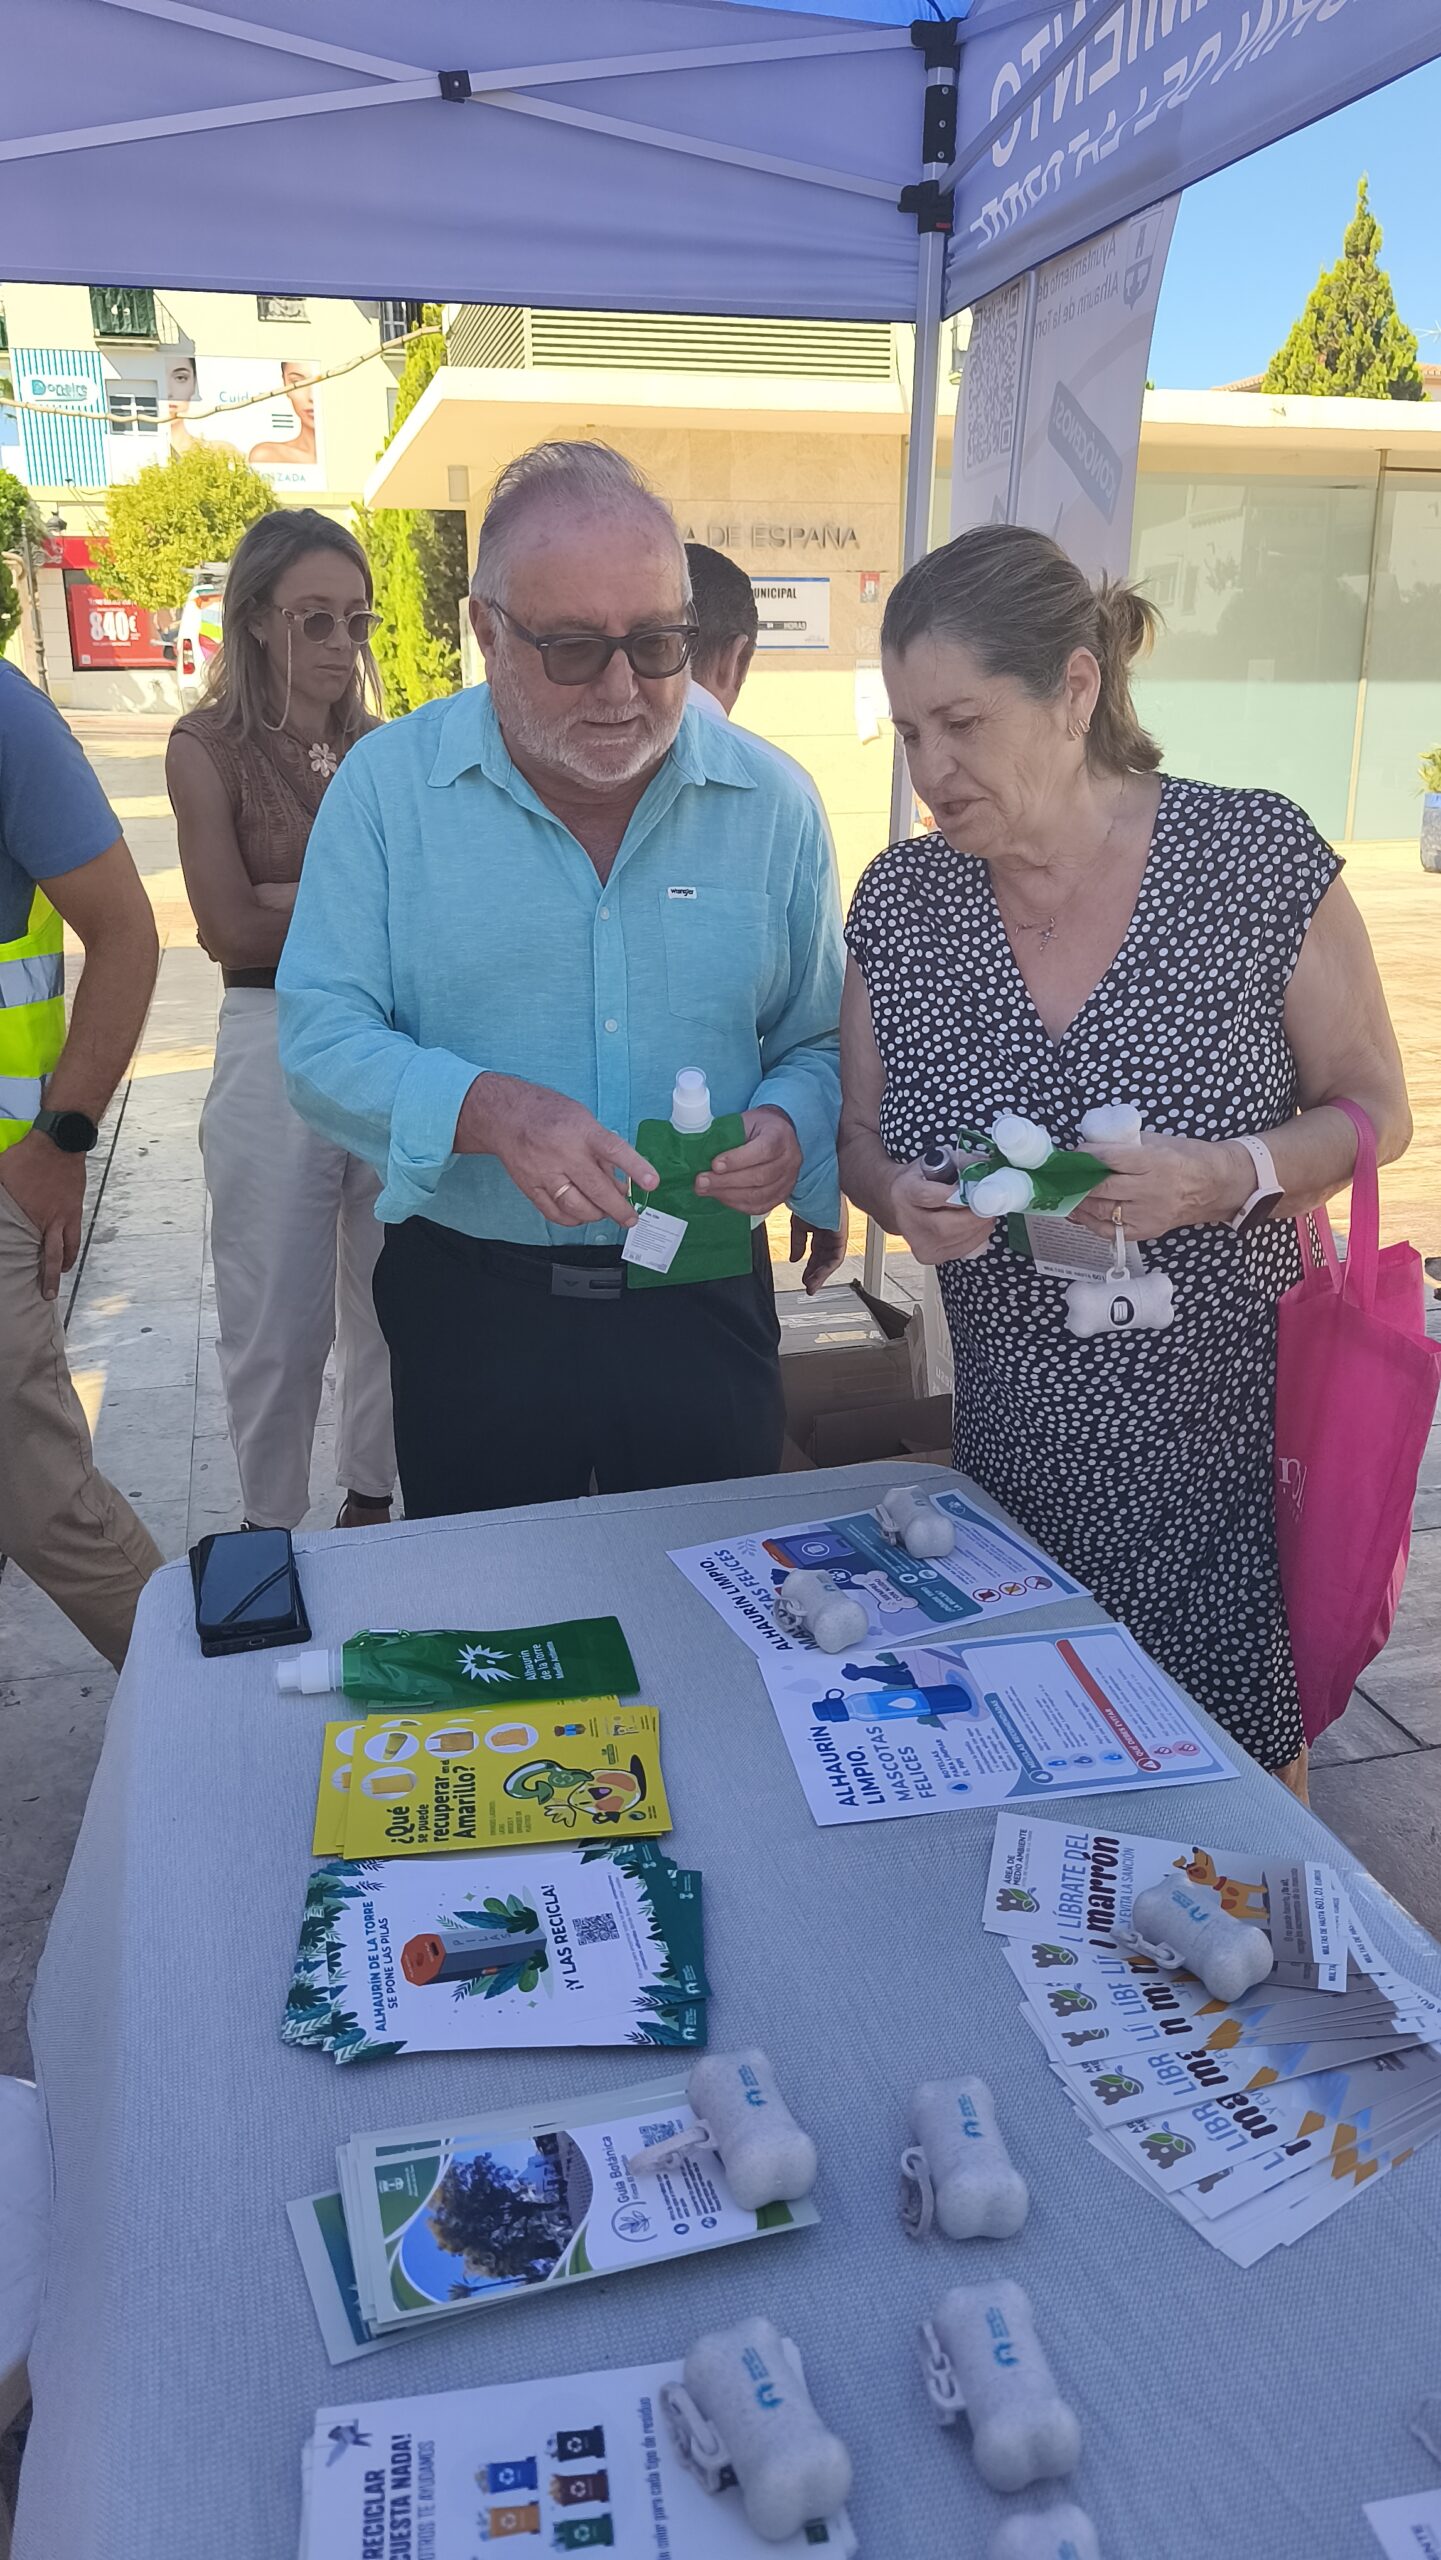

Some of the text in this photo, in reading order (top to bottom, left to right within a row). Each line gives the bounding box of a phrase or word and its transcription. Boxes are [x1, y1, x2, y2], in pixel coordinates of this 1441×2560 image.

[706, 524, 744, 548] DE
[751, 520, 861, 550] ESPAÑA
[753, 587, 797, 599] UNICIPAL
[714, 1549, 760, 1588] FELICES
[699, 1557, 794, 1651] ALHAURÍN LIMPIO,
[518, 1649, 538, 1680] Alhaurín
[532, 1643, 551, 1680] de la Torre
[808, 1726, 860, 1807] ALHAURÍN
[846, 1745, 886, 1805] LIMPIO,
[866, 1726, 914, 1802] MASCOTAS
[897, 1746, 937, 1799] FELICES
[385, 1804, 415, 1844] ¿Qué
[416, 1803, 431, 1843] se puede
[434, 1776, 455, 1842] recuperar
[452, 1765, 476, 1839] Amarillo?
[1007, 1854, 1016, 1864] DE
[1016, 1828, 1028, 1862] AMBIENTE
[1121, 1847, 1136, 1883] SANCIÓN
[1013, 1863, 1023, 1886] MEDIO
[1052, 1832, 1089, 1929] LÍBRATE DEL
[1081, 1836, 1120, 1933] marrón
[1121, 1884, 1133, 1898] LA
[540, 1884, 569, 1945] RECICLA!
[1119, 1899, 1132, 1918] EVITA
[1313, 1887, 1325, 1911] 601,01
[1317, 1911, 1327, 1927] HASTA
[362, 1900, 388, 2032] ALHAURÍN DE LA TORRE
[378, 1917, 398, 2009] SE PONE LAS PILAS
[557, 1947, 577, 1976] LAS
[1147, 2052, 1198, 2096] LÍBR
[1191, 2102, 1249, 2152] LÍBR
[602, 2135, 630, 2204] Guía Botánica
[390, 2432, 413, 2491] NADA!
[362, 2468, 386, 2560] RECICLAR
